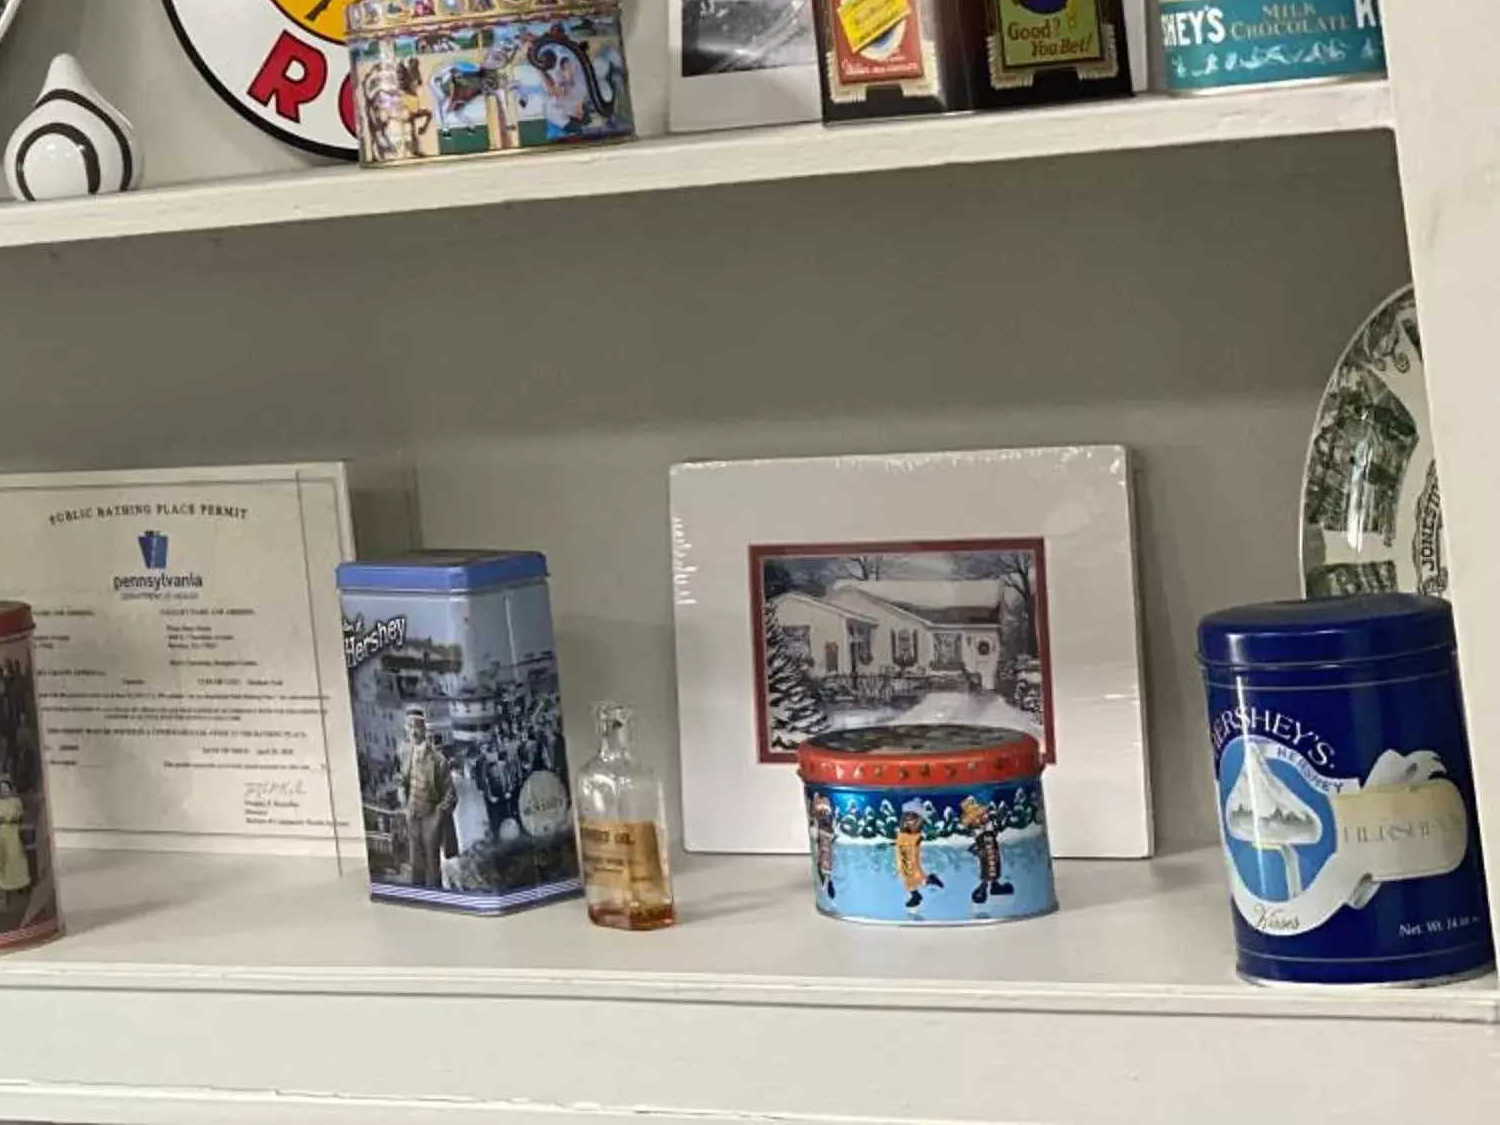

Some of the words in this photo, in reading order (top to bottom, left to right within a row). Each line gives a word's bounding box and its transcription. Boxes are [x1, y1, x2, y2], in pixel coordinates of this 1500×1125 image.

[1262, 1, 1317, 21] MILK
[1007, 18, 1061, 41] Good?
[1030, 38, 1059, 58] You
[49, 506, 93, 526] PUBLIC
[156, 503, 196, 516] PLACE
[200, 503, 249, 520] PERMIT
[113, 572, 204, 592] pennsylvania
[344, 618, 405, 668] Hershey
[1212, 706, 1336, 766] ERSHEY'S
